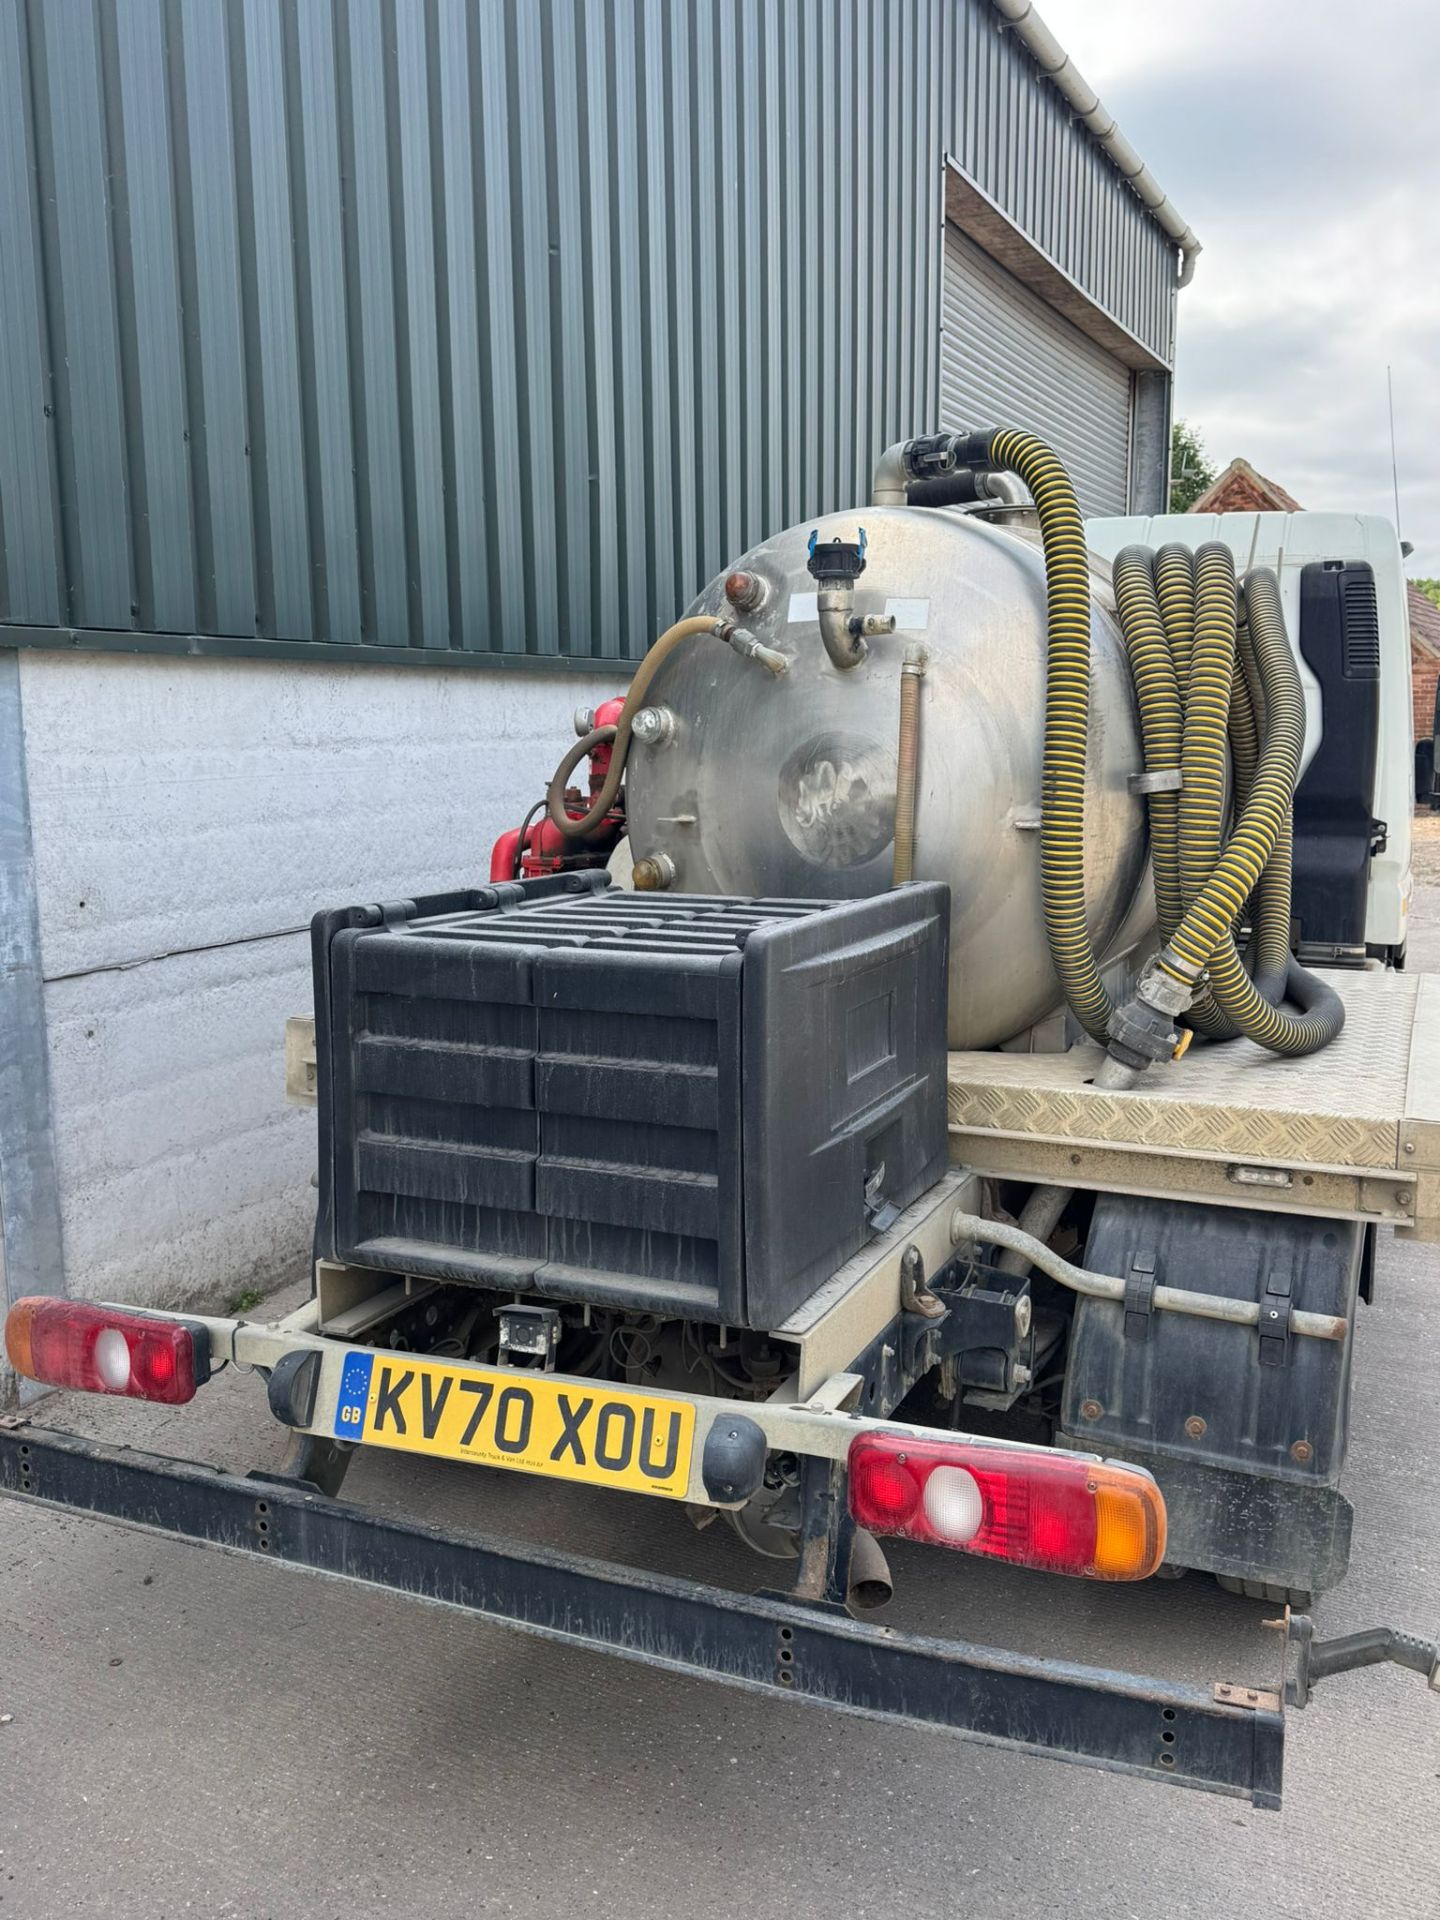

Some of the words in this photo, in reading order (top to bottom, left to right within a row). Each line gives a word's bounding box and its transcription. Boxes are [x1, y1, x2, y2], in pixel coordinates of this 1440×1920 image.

[341, 1405, 361, 1424] GB
[373, 1367, 534, 1454] KV70
[550, 1393, 682, 1479] XOU
